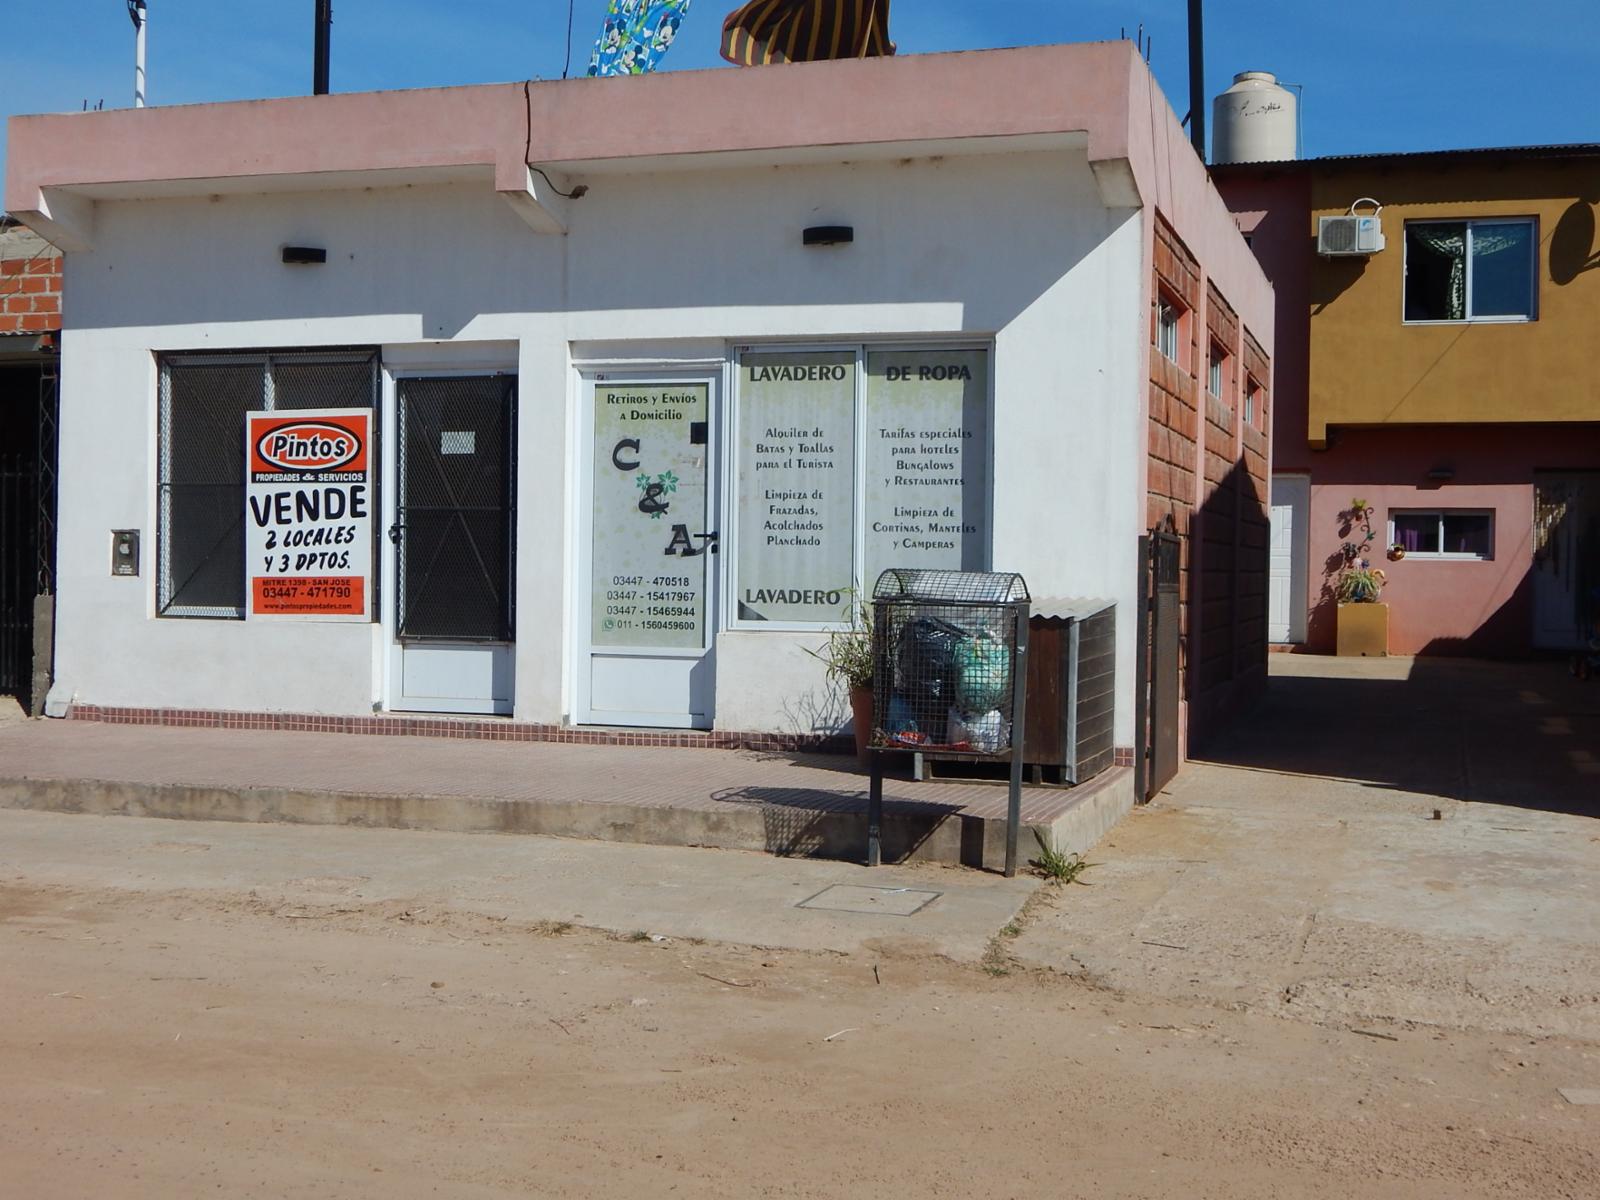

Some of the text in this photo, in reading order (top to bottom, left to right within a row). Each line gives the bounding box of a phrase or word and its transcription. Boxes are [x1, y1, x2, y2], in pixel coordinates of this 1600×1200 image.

[750, 365, 846, 382] LAVADERO
[886, 365, 972, 381] DE ROPA
[272, 434, 348, 459] Pintos
[612, 438, 640, 471] C
[255, 472, 363, 482] PROPIEDADES & SERVICIOS
[249, 485, 367, 527] VENDE
[638, 483, 669, 515] &
[265, 525, 356, 550] 2 LOCALES
[664, 524, 697, 557] A
[279, 554, 290, 573] 3
[295, 550, 351, 571] DPTOS.
[612, 576, 643, 586] 03447
[652, 577, 690, 587] 470518
[262, 587, 298, 598] 03447
[306, 587, 351, 598] 471790
[607, 590, 637, 600] 03447
[647, 591, 695, 601] 15417967
[746, 588, 841, 605] LAVADERO
[606, 606, 637, 615] 03447
[647, 606, 695, 616] 15465944
[617, 620, 632, 629] 011
[641, 620, 695, 631] 1560459600
